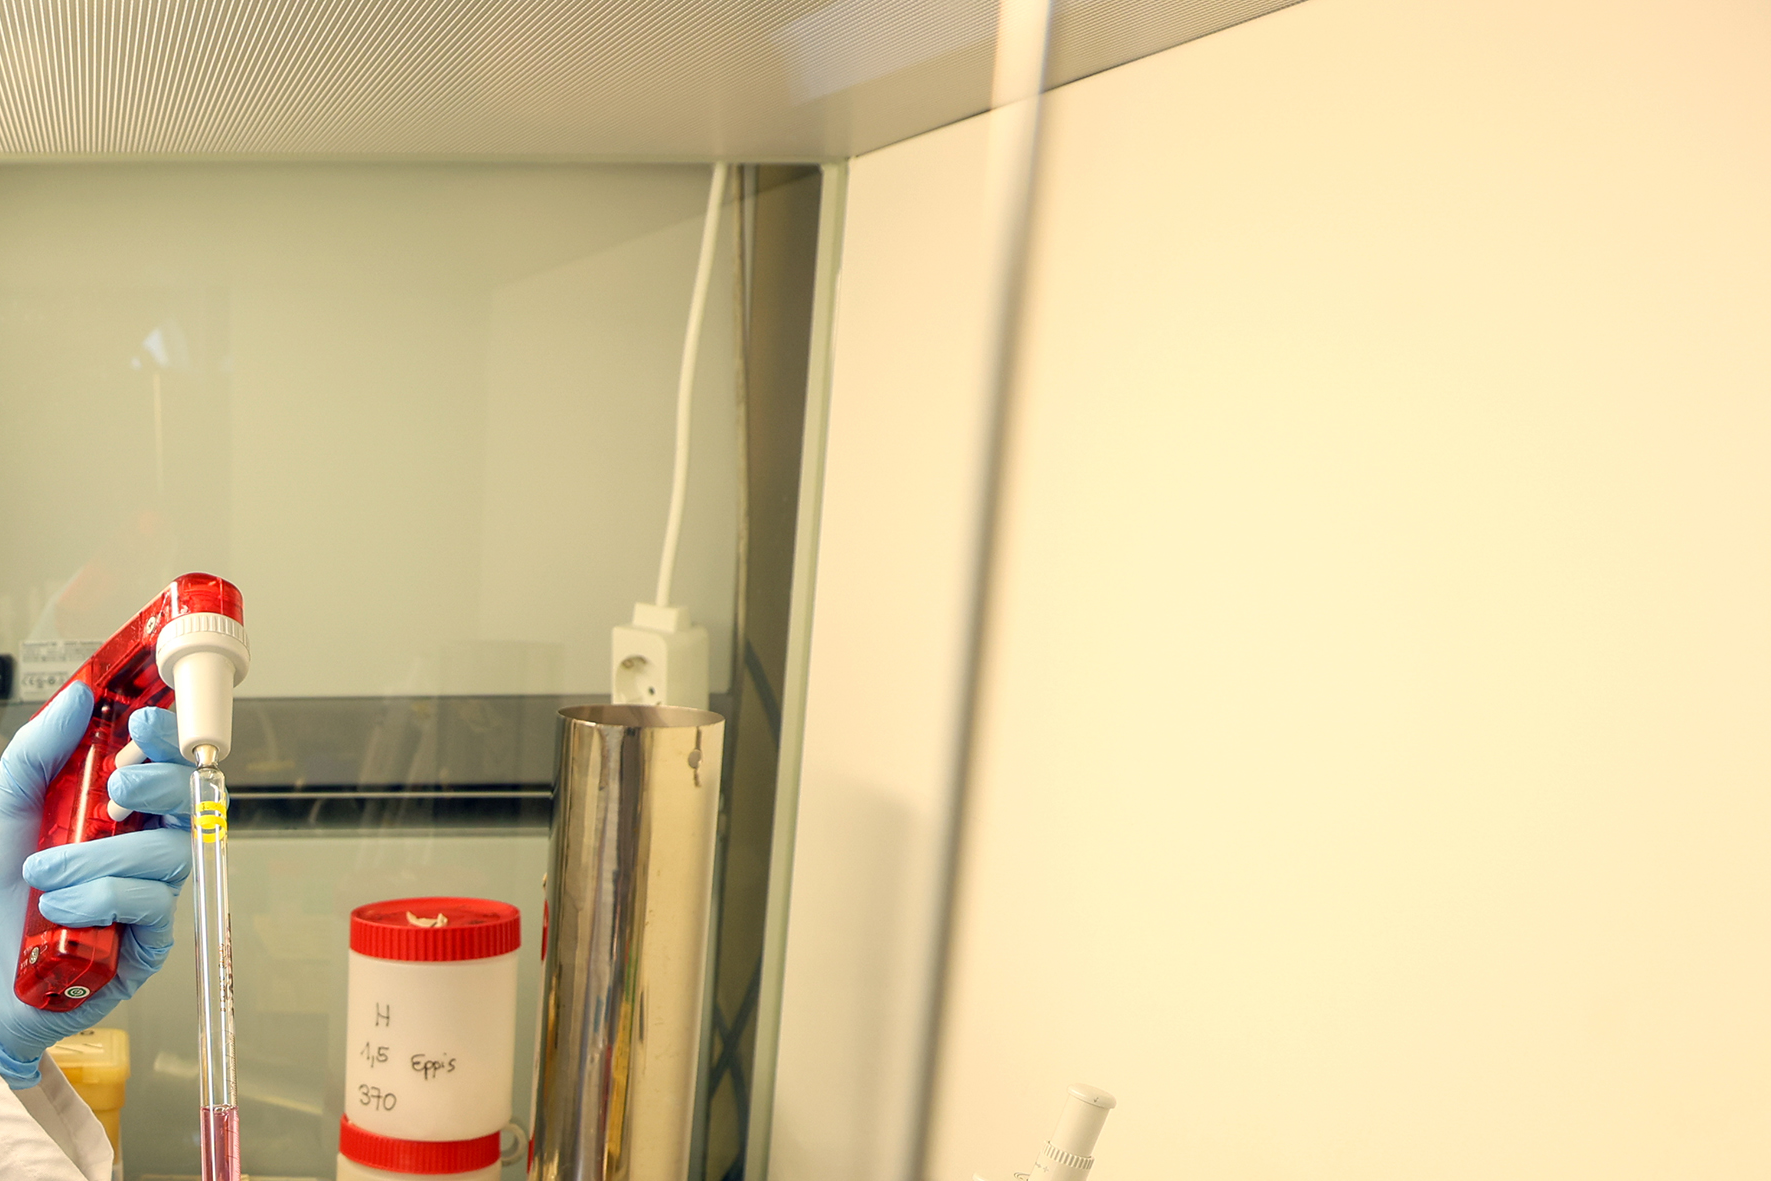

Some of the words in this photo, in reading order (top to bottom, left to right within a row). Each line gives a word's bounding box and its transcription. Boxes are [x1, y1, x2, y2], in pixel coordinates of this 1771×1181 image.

[374, 1001, 391, 1028] H
[360, 1041, 390, 1068] 1,5
[358, 1083, 398, 1111] 370
